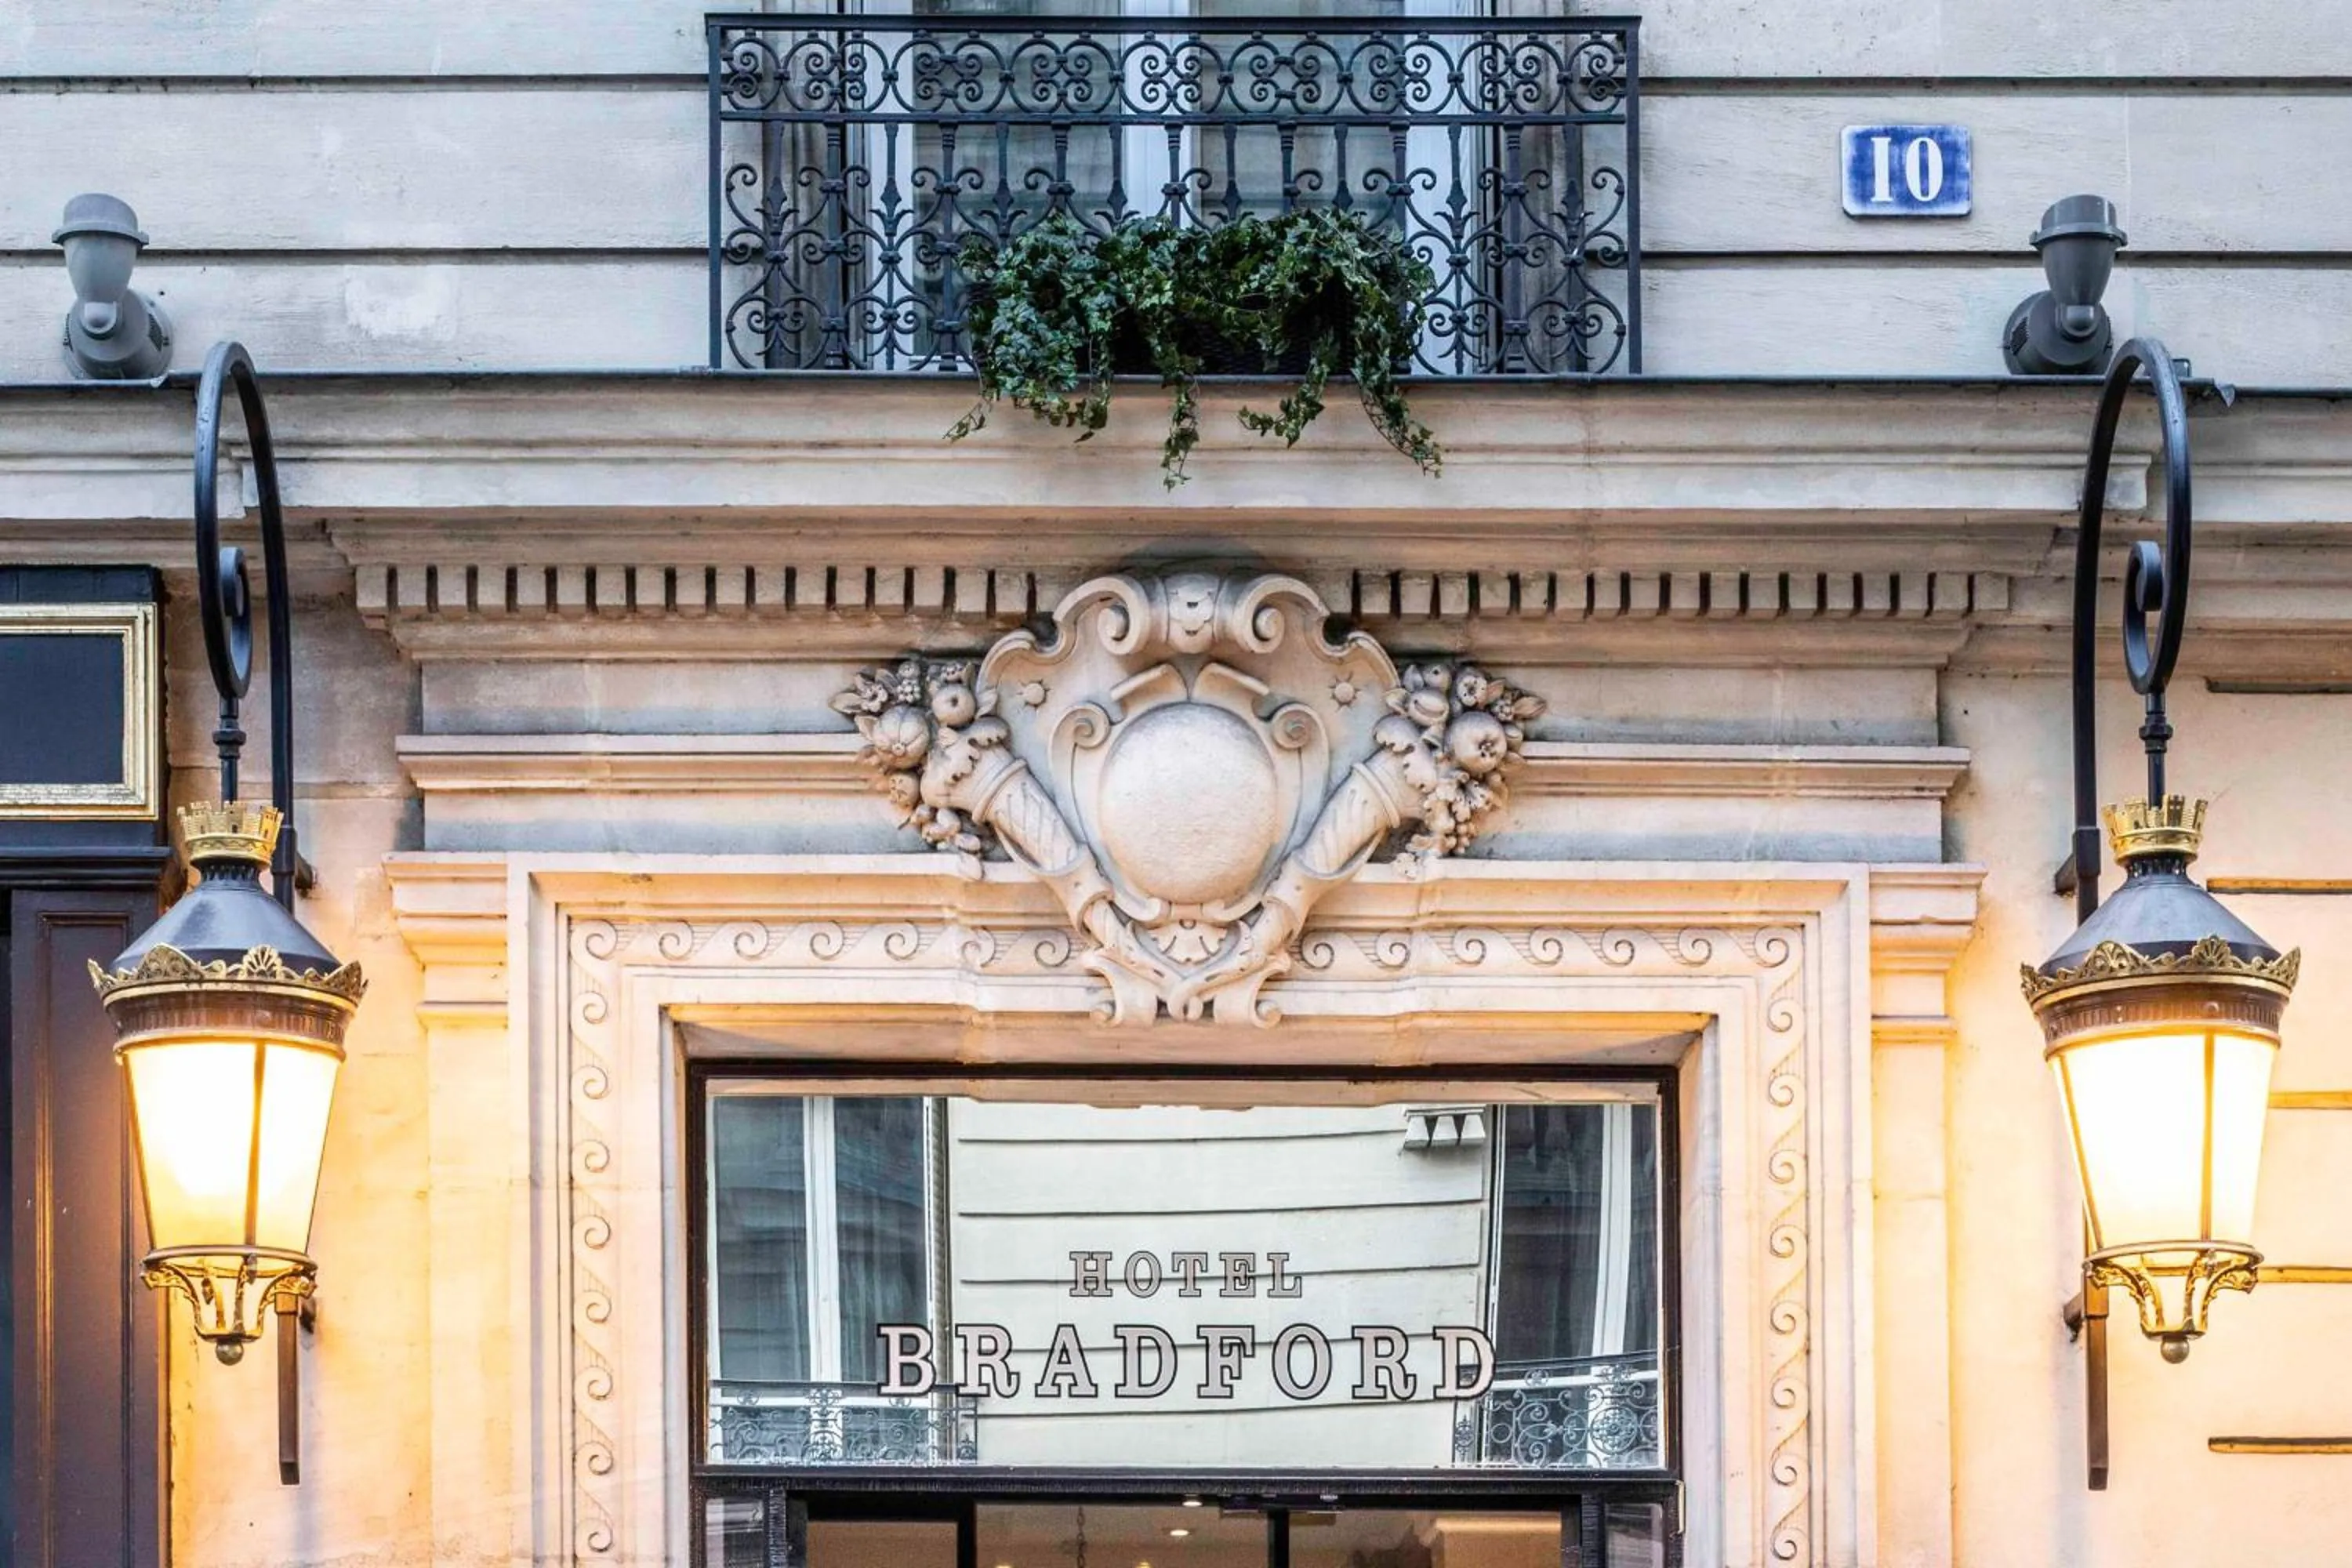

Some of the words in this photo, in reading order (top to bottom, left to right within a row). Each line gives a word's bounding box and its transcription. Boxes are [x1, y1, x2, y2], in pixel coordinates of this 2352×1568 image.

[1871, 137, 1944, 201] 10
[1069, 1251, 1303, 1298] HOTEL
[877, 1323, 1496, 1399] BRADFORD
